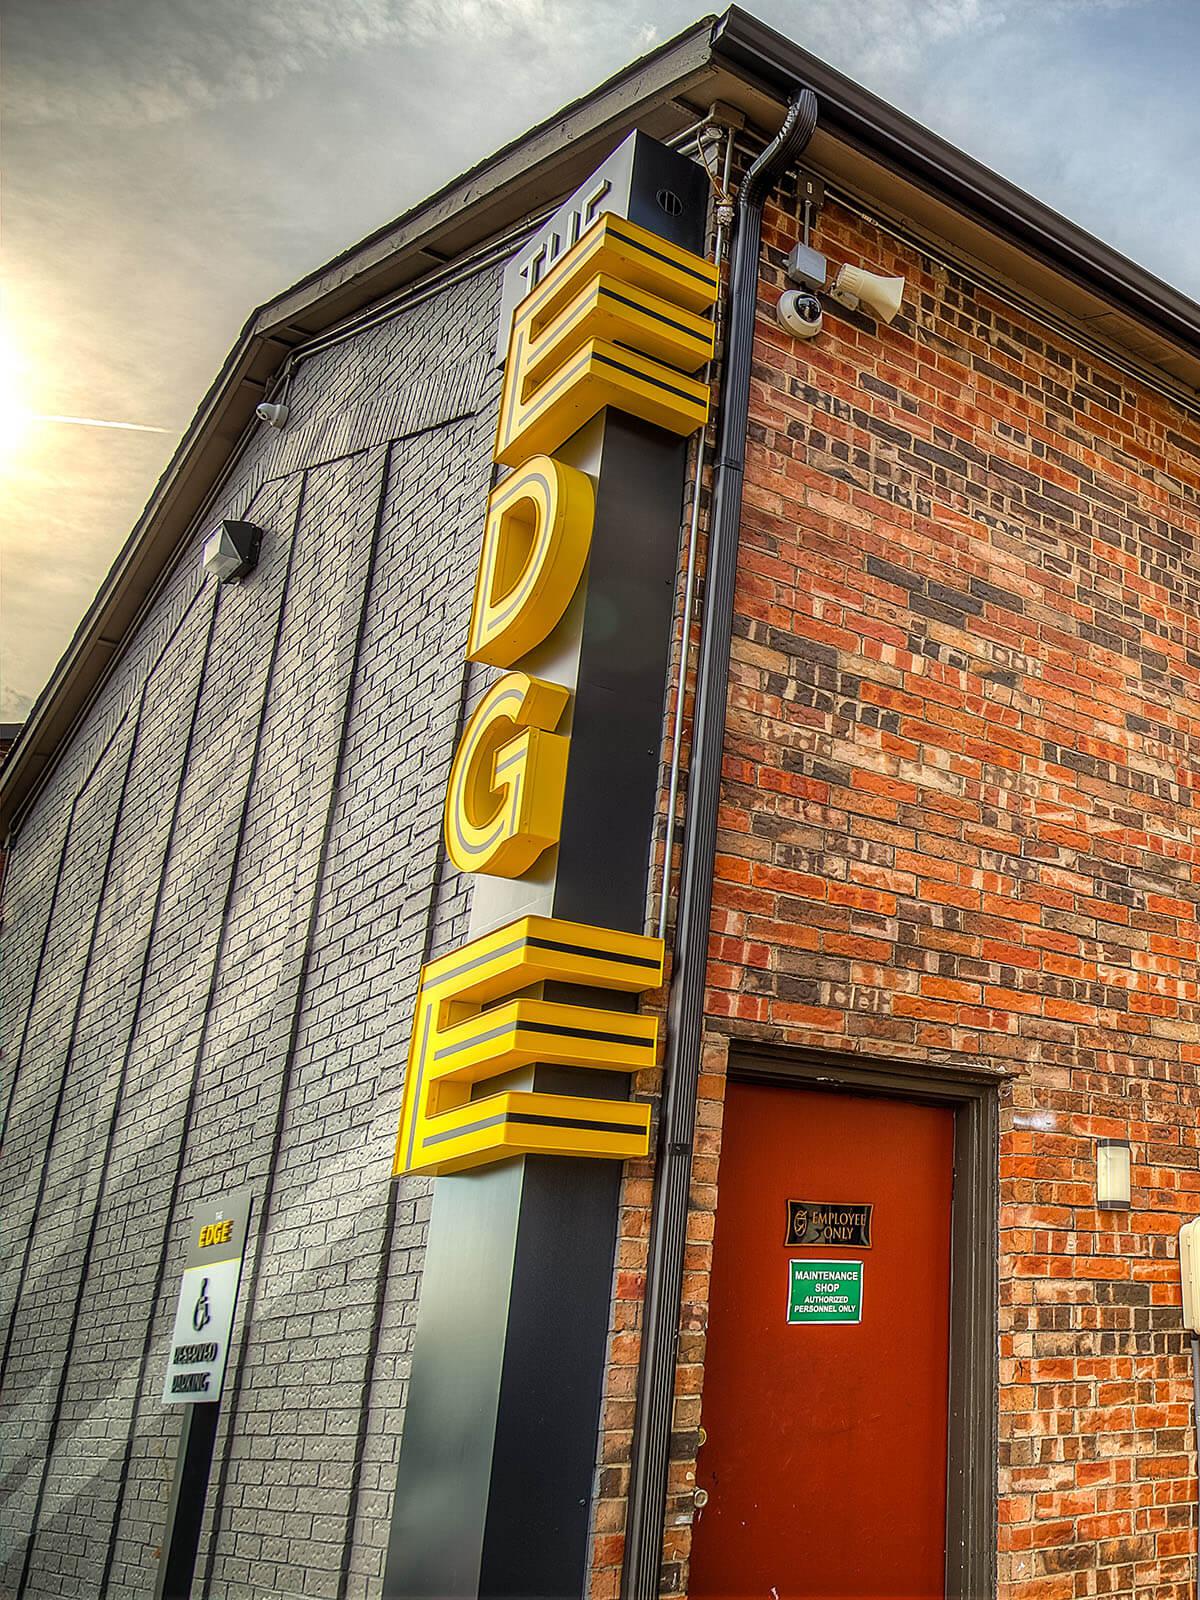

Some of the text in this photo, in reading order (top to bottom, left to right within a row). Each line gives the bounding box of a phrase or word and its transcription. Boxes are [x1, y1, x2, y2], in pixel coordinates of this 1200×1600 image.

[392, 211, 719, 1177] EDGE
[812, 1211, 866, 1226] EMPLOYEE
[198, 1219, 235, 1249] EDGE
[823, 1225, 854, 1240] ONLY
[795, 1271, 859, 1281] MAINTENANCE
[815, 1283, 840, 1292] SHOP
[804, 1296, 849, 1304] AUTHORIZED
[794, 1305, 856, 1313] PERSONNEL ONLY
[173, 1342, 218, 1365] RESERVED
[171, 1371, 211, 1393] PARKING
